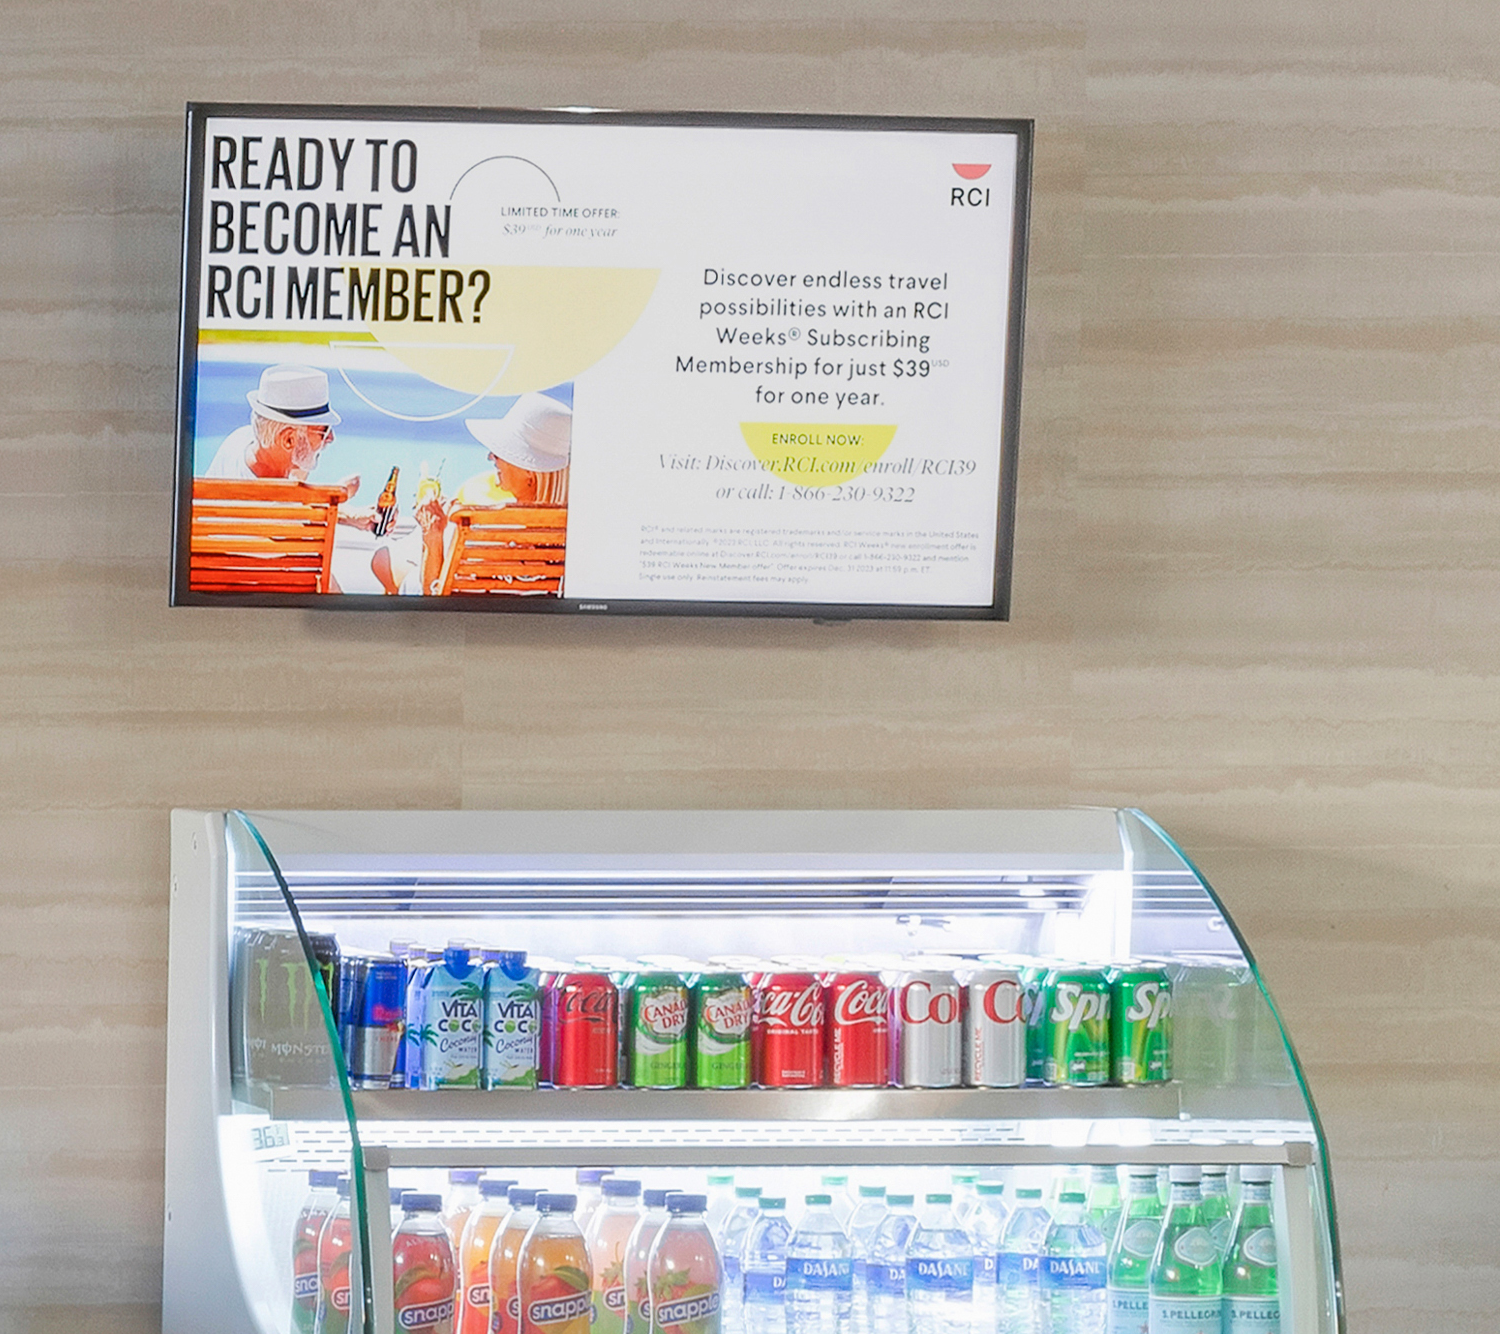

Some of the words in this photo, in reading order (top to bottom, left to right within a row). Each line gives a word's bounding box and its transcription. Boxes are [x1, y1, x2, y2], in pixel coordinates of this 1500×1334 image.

[211, 135, 355, 192] READY
[365, 138, 418, 193] TO
[950, 187, 990, 207] RCI
[501, 207, 548, 217] LIMITED
[551, 207, 579, 218] TIME
[582, 208, 620, 219] OFFER:
[208, 200, 383, 258] BECOME
[392, 204, 452, 259] AN
[704, 268, 797, 288] Discover
[803, 270, 882, 289] endless
[889, 273, 948, 291] travel
[206, 264, 275, 320] RCI
[286, 266, 491, 324] MEMBER?
[700, 298, 826, 319] possibilities
[833, 300, 877, 318] with
[884, 305, 906, 319] an
[913, 302, 949, 319] RCI
[807, 329, 930, 353] Subscribing
[675, 356, 807, 379] Membership
[813, 357, 843, 375] for
[847, 358, 886, 381] just
[756, 385, 784, 404] for
[791, 389, 829, 405] one
[835, 390, 885, 409] year.
[772, 433, 822, 445] ENROLL
[827, 434, 864, 446] NOW:
[659, 453, 701, 470] Visit:
[716, 485, 733, 499] or
[737, 483, 774, 501] call:
[778, 484, 915, 503] 1-866-230-9322
[442, 999, 478, 1018] VITA
[498, 1000, 534, 1019] VITA
[644, 998, 688, 1023] CANAD
[706, 1000, 752, 1023] CANAD
[900, 980, 962, 1024] Co
[662, 1014, 687, 1030] DRY
[724, 1014, 751, 1030] DRY
[271, 1041, 331, 1057] MONSTE
[657, 1293, 719, 1323] snapple
